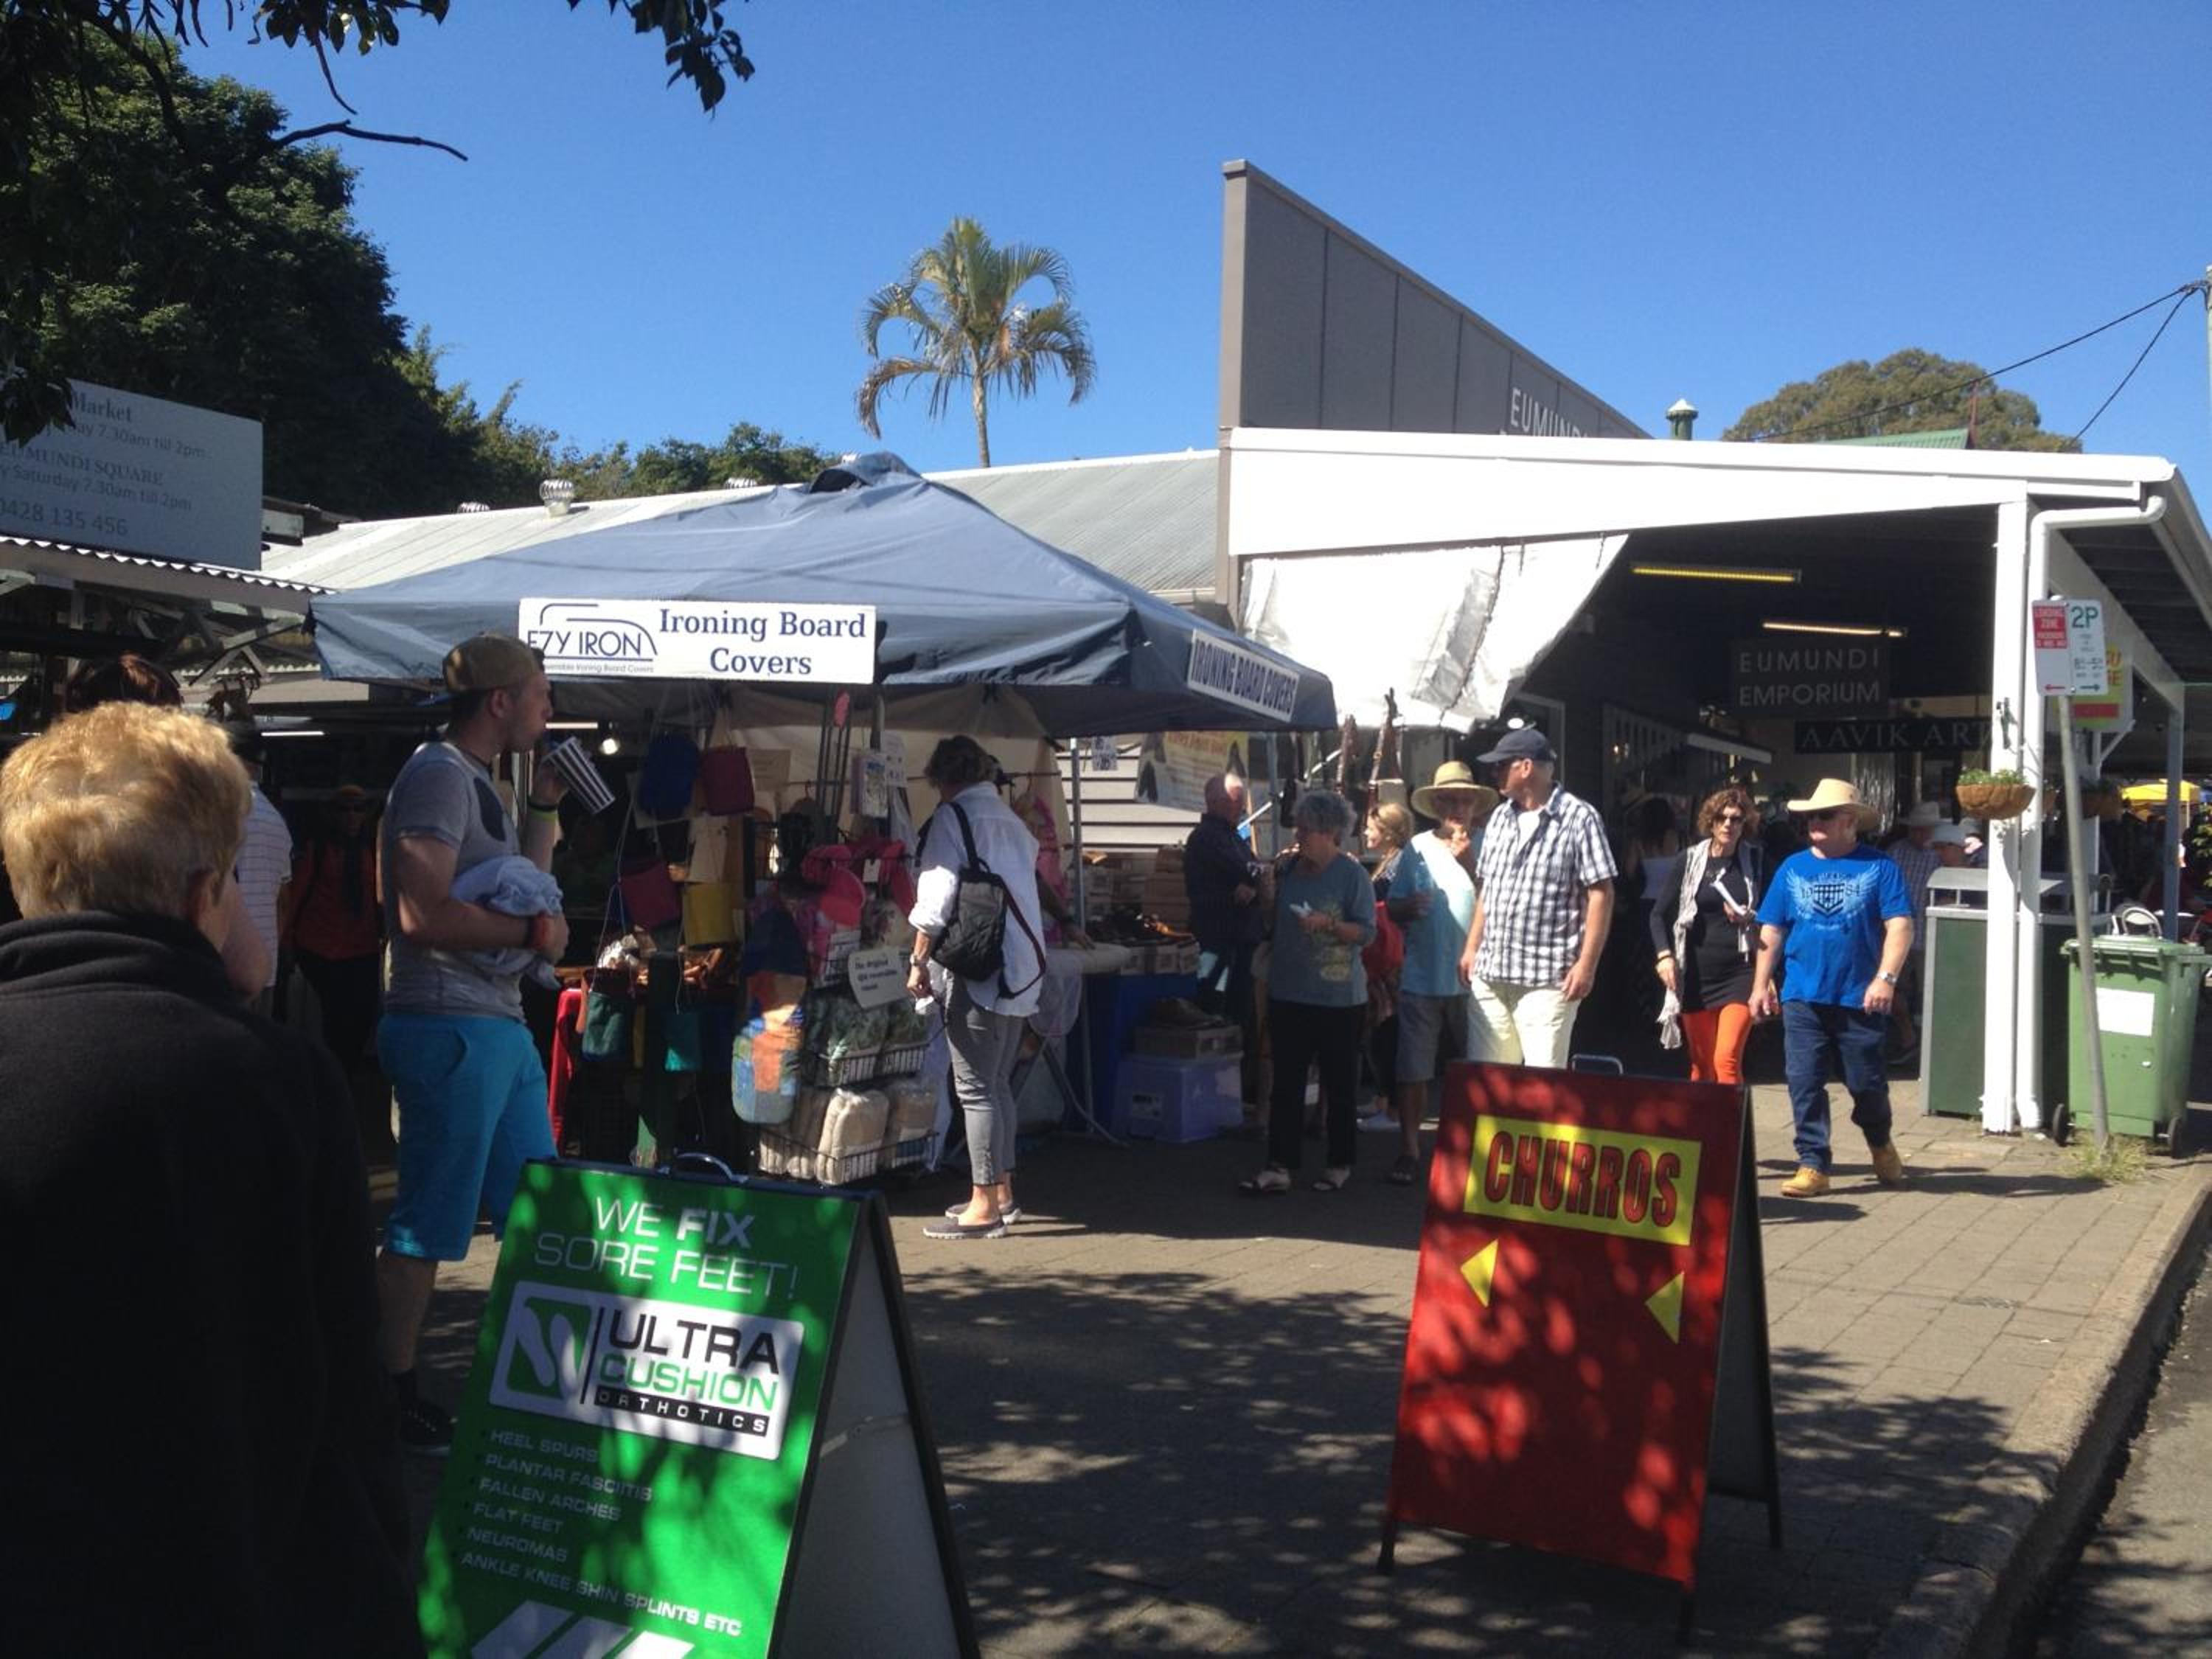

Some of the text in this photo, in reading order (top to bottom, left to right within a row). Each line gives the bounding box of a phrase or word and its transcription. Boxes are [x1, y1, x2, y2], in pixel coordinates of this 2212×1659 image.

[1511, 387, 1589, 437] EUMUN
[13, 464, 79, 493] Saturday
[94, 460, 164, 485] SQUARE
[52, 507, 86, 529] 135
[93, 515, 128, 536] 456
[659, 609, 866, 641] Ironing Board
[2071, 606, 2098, 628] 2P
[580, 630, 641, 656] IRON
[709, 647, 812, 674] Covers
[1739, 648, 1879, 672] EUMUNDI
[1739, 682, 1879, 706] EMPORIUM
[1484, 1130, 1682, 1228] CHURROS
[597, 1197, 755, 1248] WE FIX
[535, 1232, 799, 1298] SORE FEET!
[609, 1309, 779, 1375] ULTRA
[599, 1352, 778, 1411] CUSHION
[598, 1391, 767, 1433] ORTHOTICS
[490, 1430, 598, 1463] HEEL SPURS
[484, 1453, 565, 1479] PLANTAR
[479, 1477, 622, 1521] FALLEN ARCHES
[473, 1502, 565, 1534] FLAT FEET
[467, 1527, 568, 1562] NEUROMAS
[461, 1552, 742, 1637] ANKLE KNEE SHIN SPLINTS ETC
